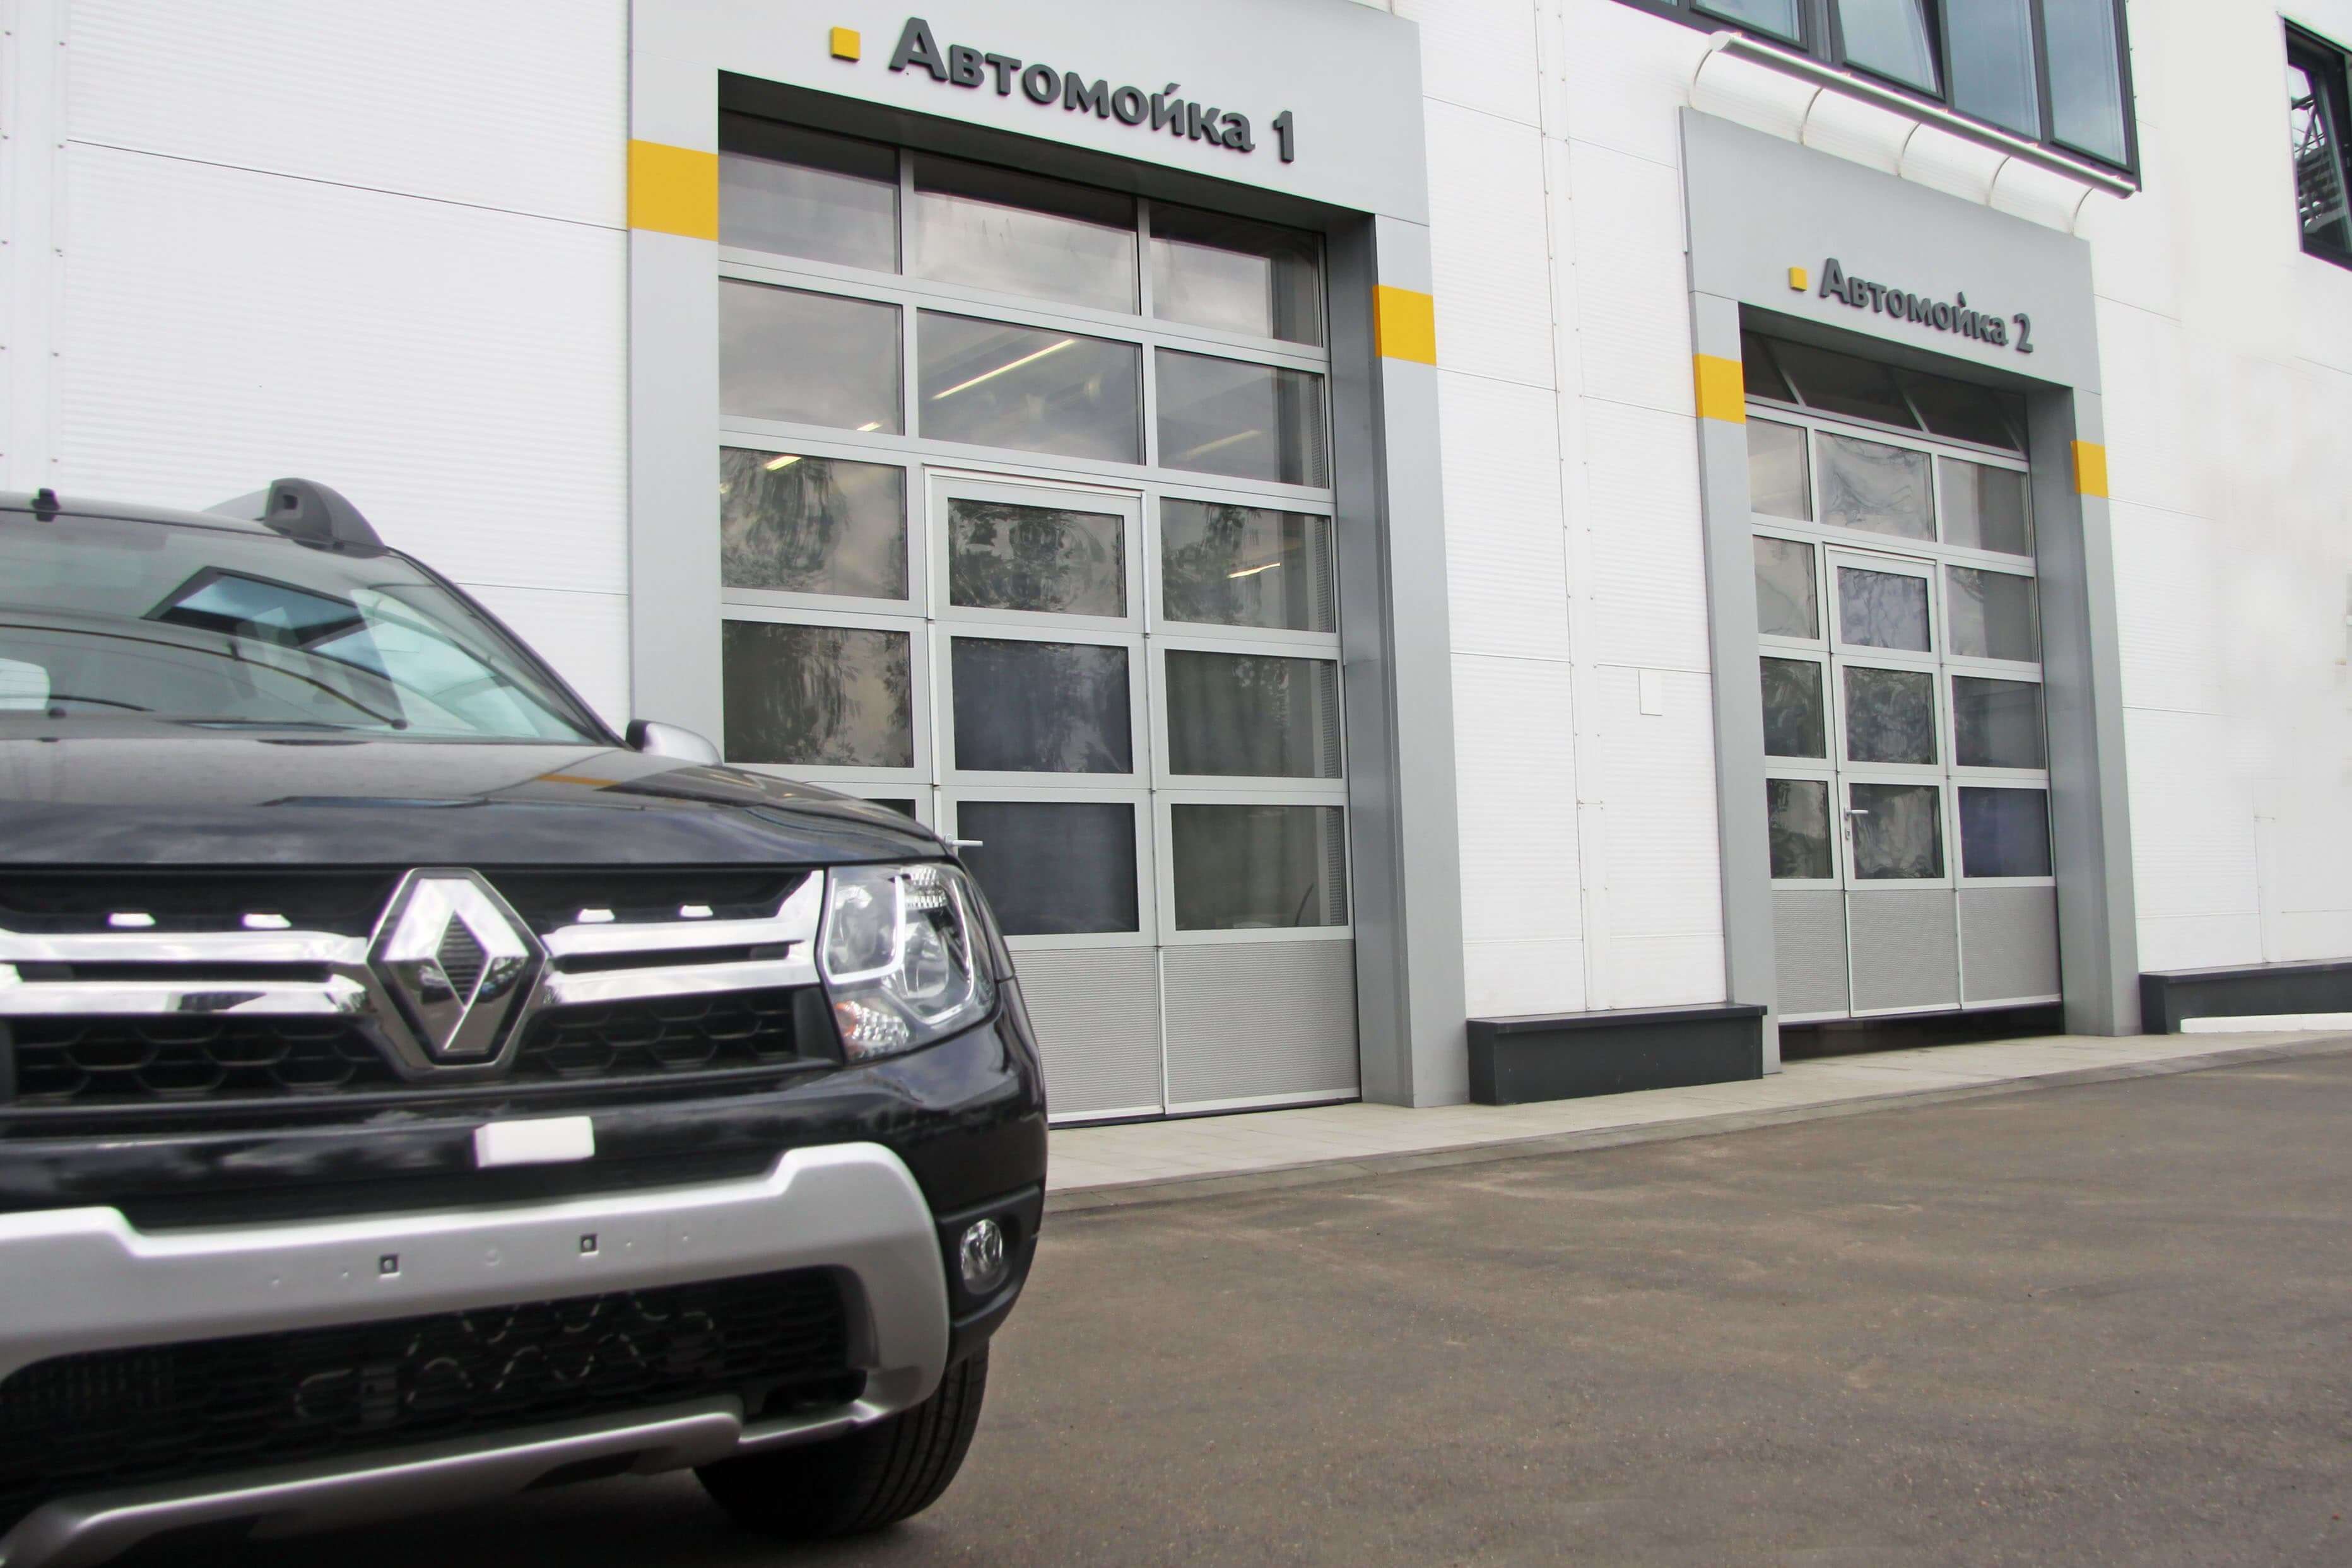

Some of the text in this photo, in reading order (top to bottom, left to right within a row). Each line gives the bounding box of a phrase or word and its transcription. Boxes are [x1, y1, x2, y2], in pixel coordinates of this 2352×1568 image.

[889, 16, 1295, 163] Автомойка 1
[1820, 257, 2033, 353] Автомойка 2
